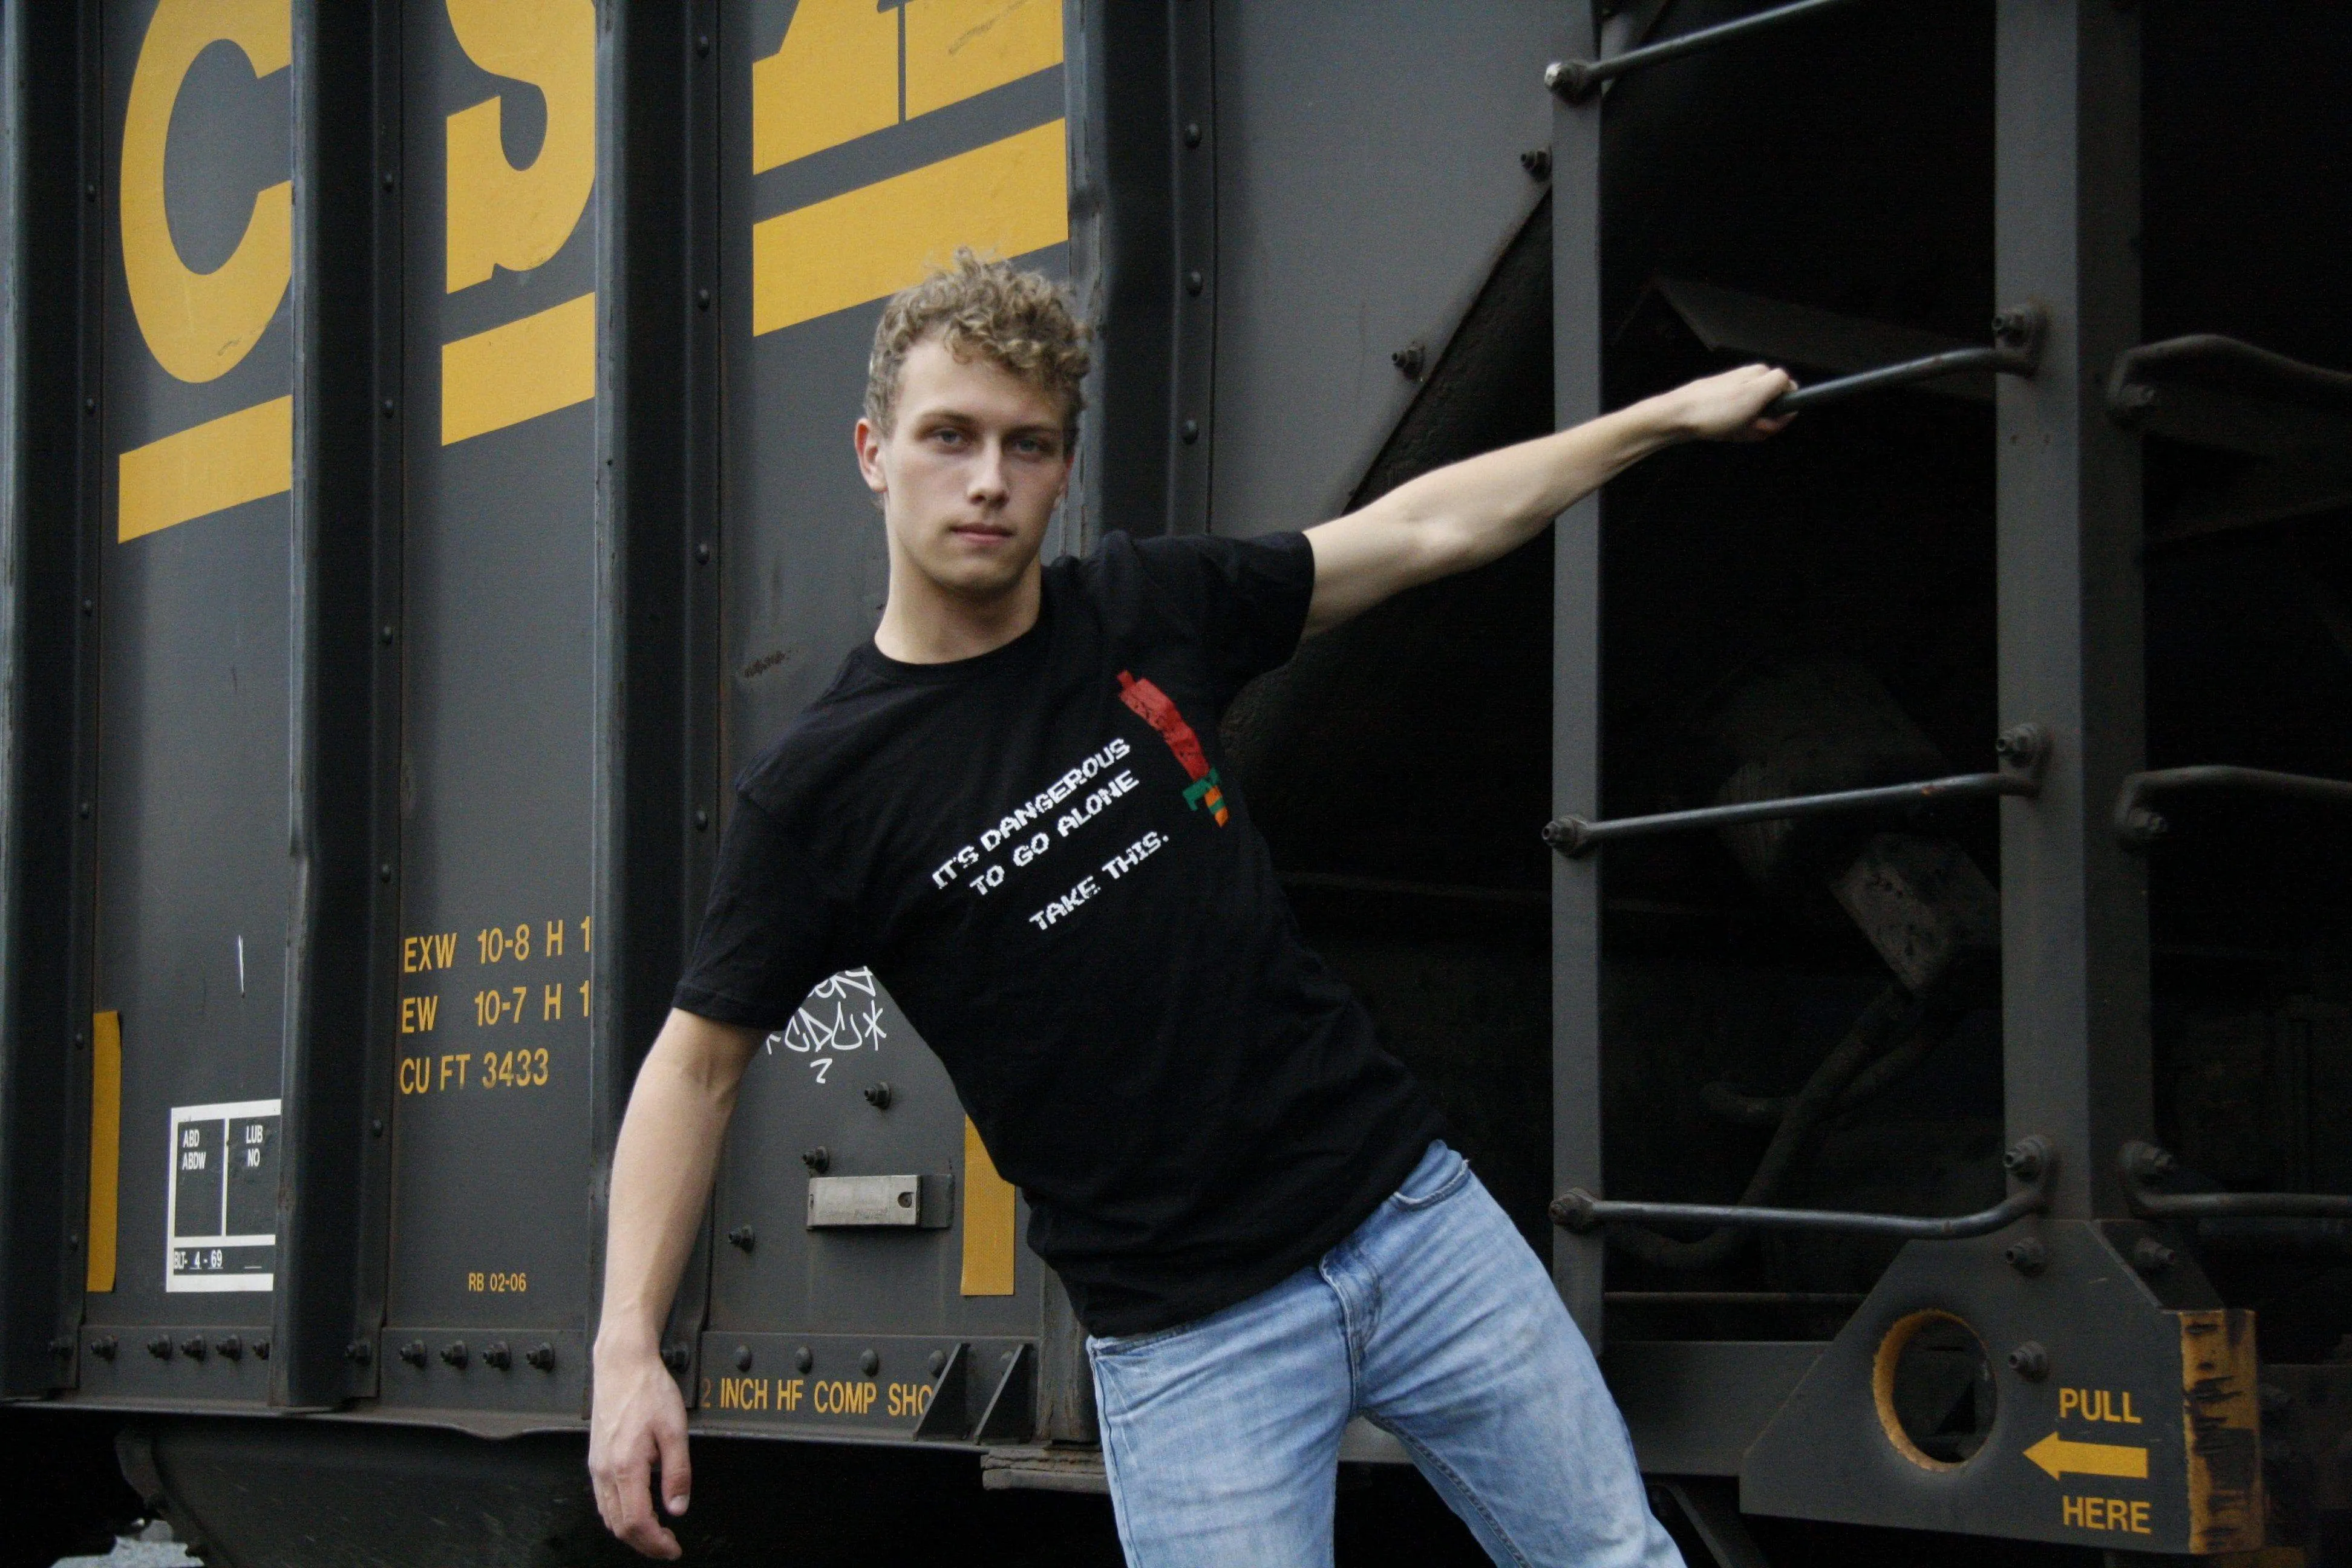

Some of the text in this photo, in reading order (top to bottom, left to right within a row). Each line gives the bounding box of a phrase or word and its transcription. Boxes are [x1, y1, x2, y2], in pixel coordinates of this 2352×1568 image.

[932, 738, 1131, 889] IT'S DANGEROUS
[969, 769, 1140, 895] TO GO ALONE
[1028, 831, 1169, 930] TAKE THIS.
[404, 932, 457, 973] EXW
[477, 924, 530, 964] 10-8
[546, 919, 563, 957] H
[402, 995, 438, 1033] EW
[474, 986, 527, 1027] 10-7
[544, 983, 561, 1021] H
[400, 1048, 549, 1095] CU FT 3433
[183, 1129, 200, 1148] ABD
[246, 1125, 263, 1144] LUB
[182, 1152, 206, 1171] ABDW
[247, 1148, 260, 1167] NO
[468, 1273, 526, 1292] RB 02-06
[720, 1377, 767, 1410] INCH
[777, 1379, 803, 1411] HF
[814, 1380, 876, 1414] COMP
[2059, 1387, 2143, 1424] PULL
[2062, 1495, 2152, 1534] HERE
